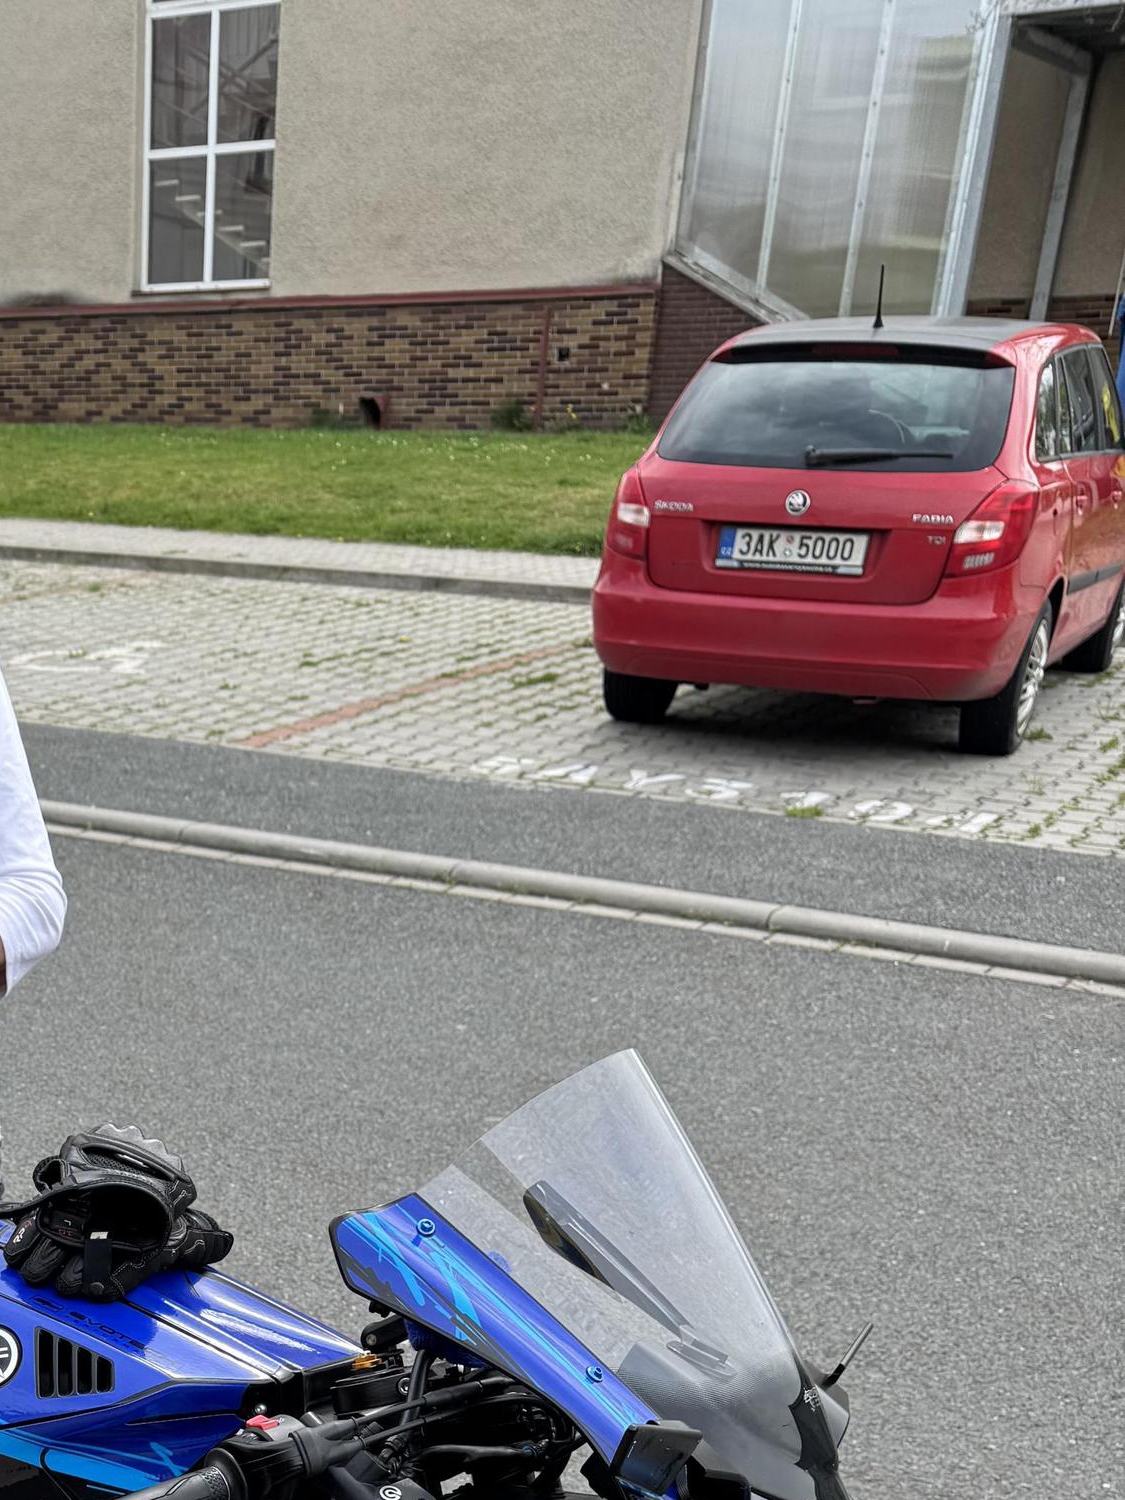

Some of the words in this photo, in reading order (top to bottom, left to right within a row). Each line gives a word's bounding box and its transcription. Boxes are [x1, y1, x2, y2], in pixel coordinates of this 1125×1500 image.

[912, 513, 954, 524] FABIA
[739, 532, 777, 558] 3AK
[797, 534, 855, 562] 5000
